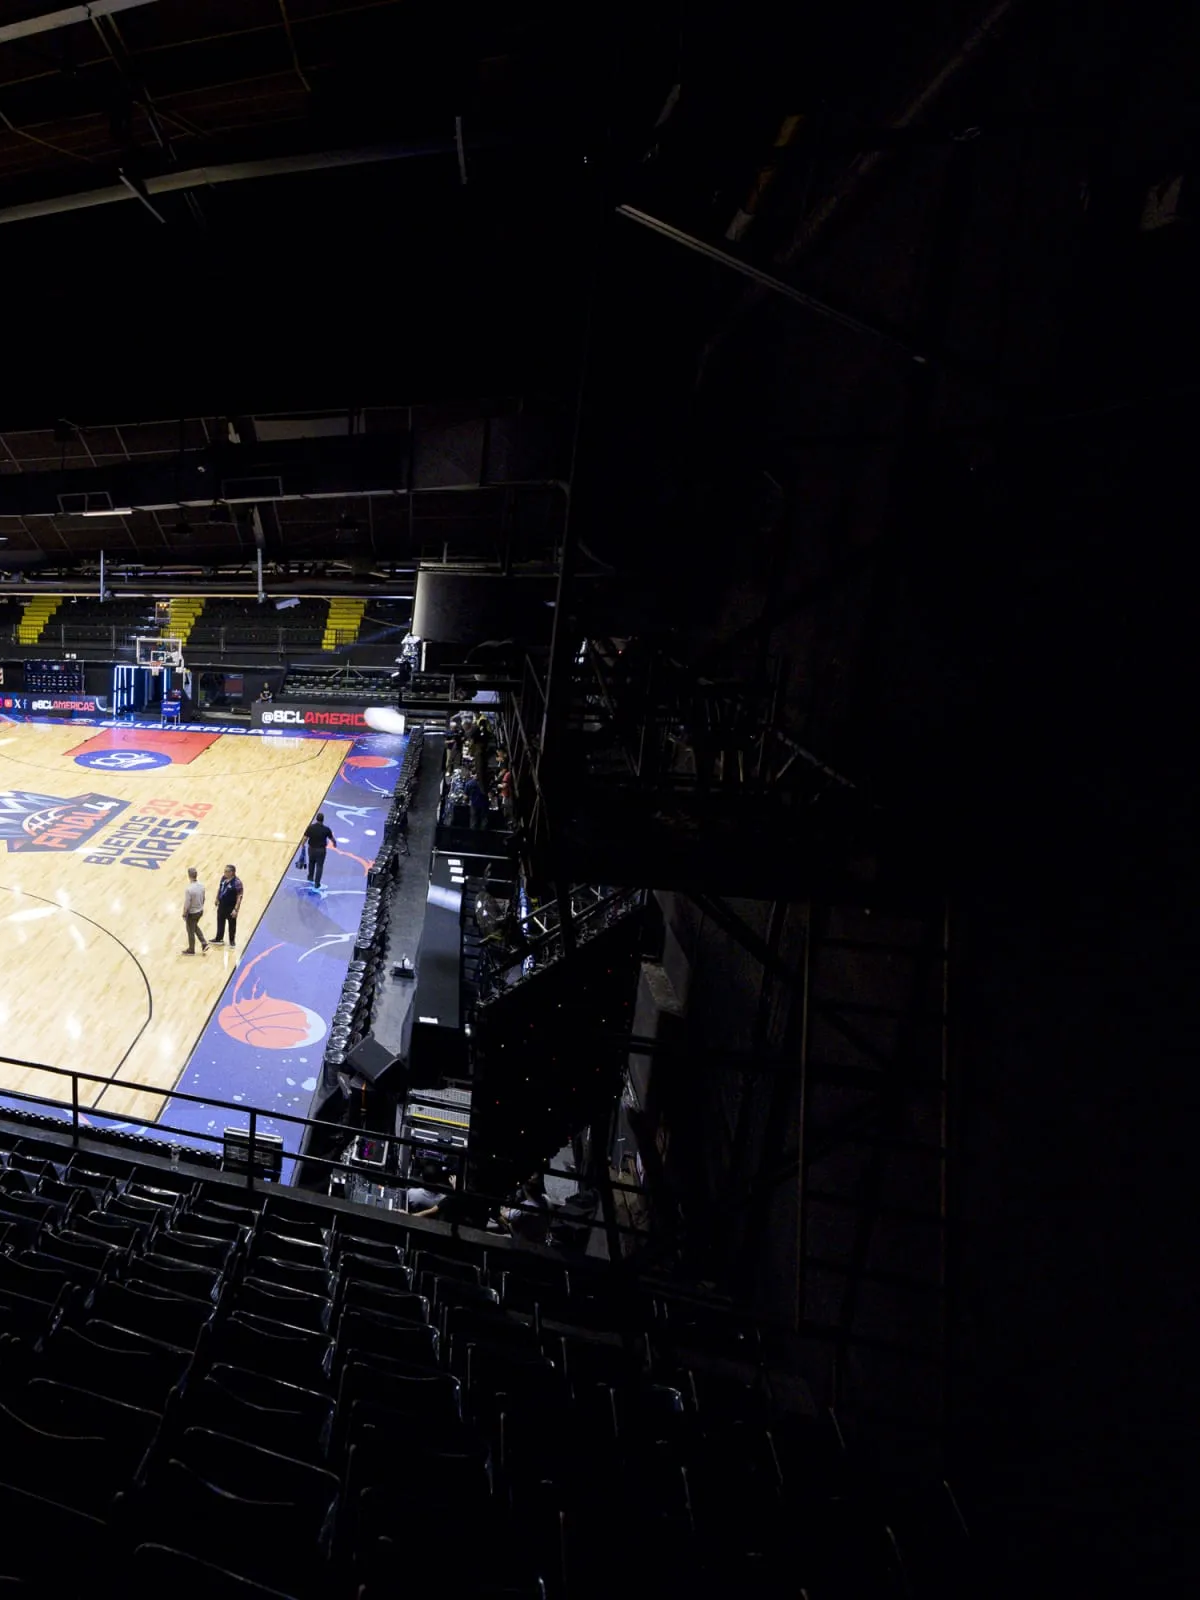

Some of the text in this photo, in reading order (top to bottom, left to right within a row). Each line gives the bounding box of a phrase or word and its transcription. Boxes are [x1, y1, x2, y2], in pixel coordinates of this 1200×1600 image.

[31, 699, 95, 711] @BCLAMERICAS
[261, 710, 368, 727] @BCLAMERIC
[31, 801, 120, 848] FINAL 4
[83, 799, 180, 865] BUENOS 20
[120, 802, 213, 870] AIRES 26
